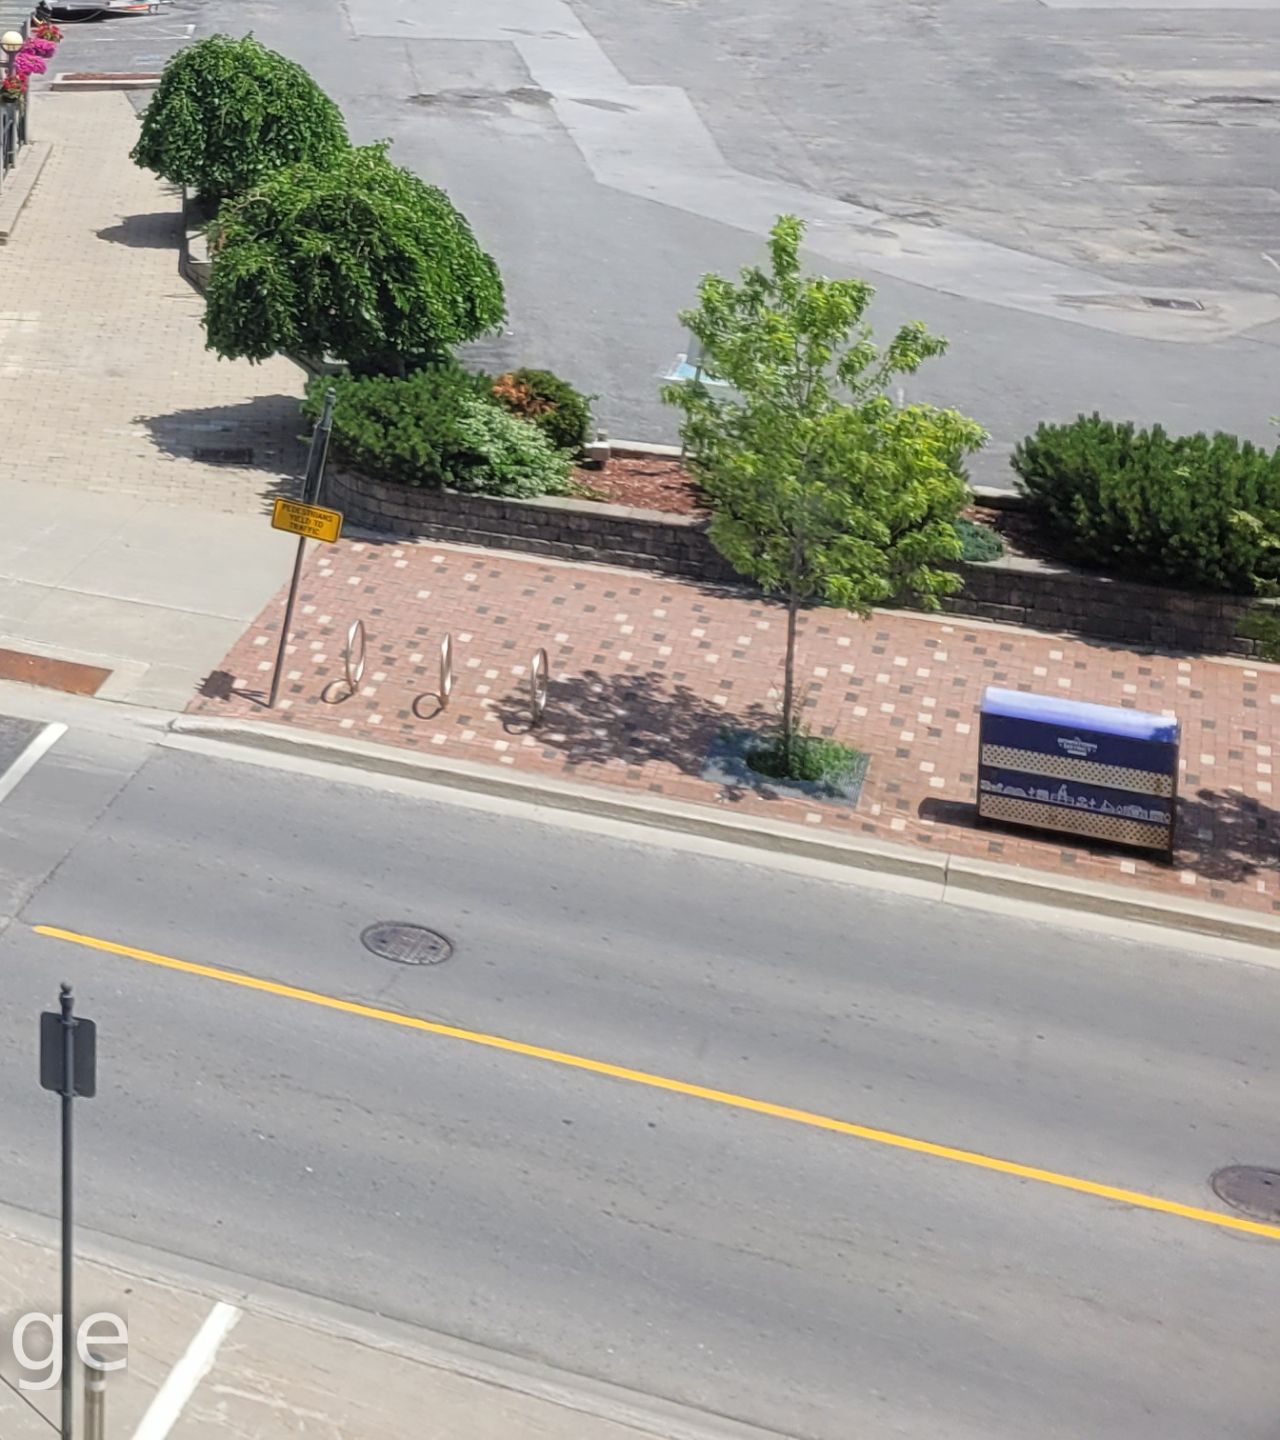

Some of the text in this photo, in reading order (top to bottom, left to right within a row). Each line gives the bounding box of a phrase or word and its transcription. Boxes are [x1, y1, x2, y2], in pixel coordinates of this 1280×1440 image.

[281, 503, 333, 523] PEDESTRIANS
[289, 513, 324, 528] YIELD TO
[289, 522, 320, 536] TRAFFIC
